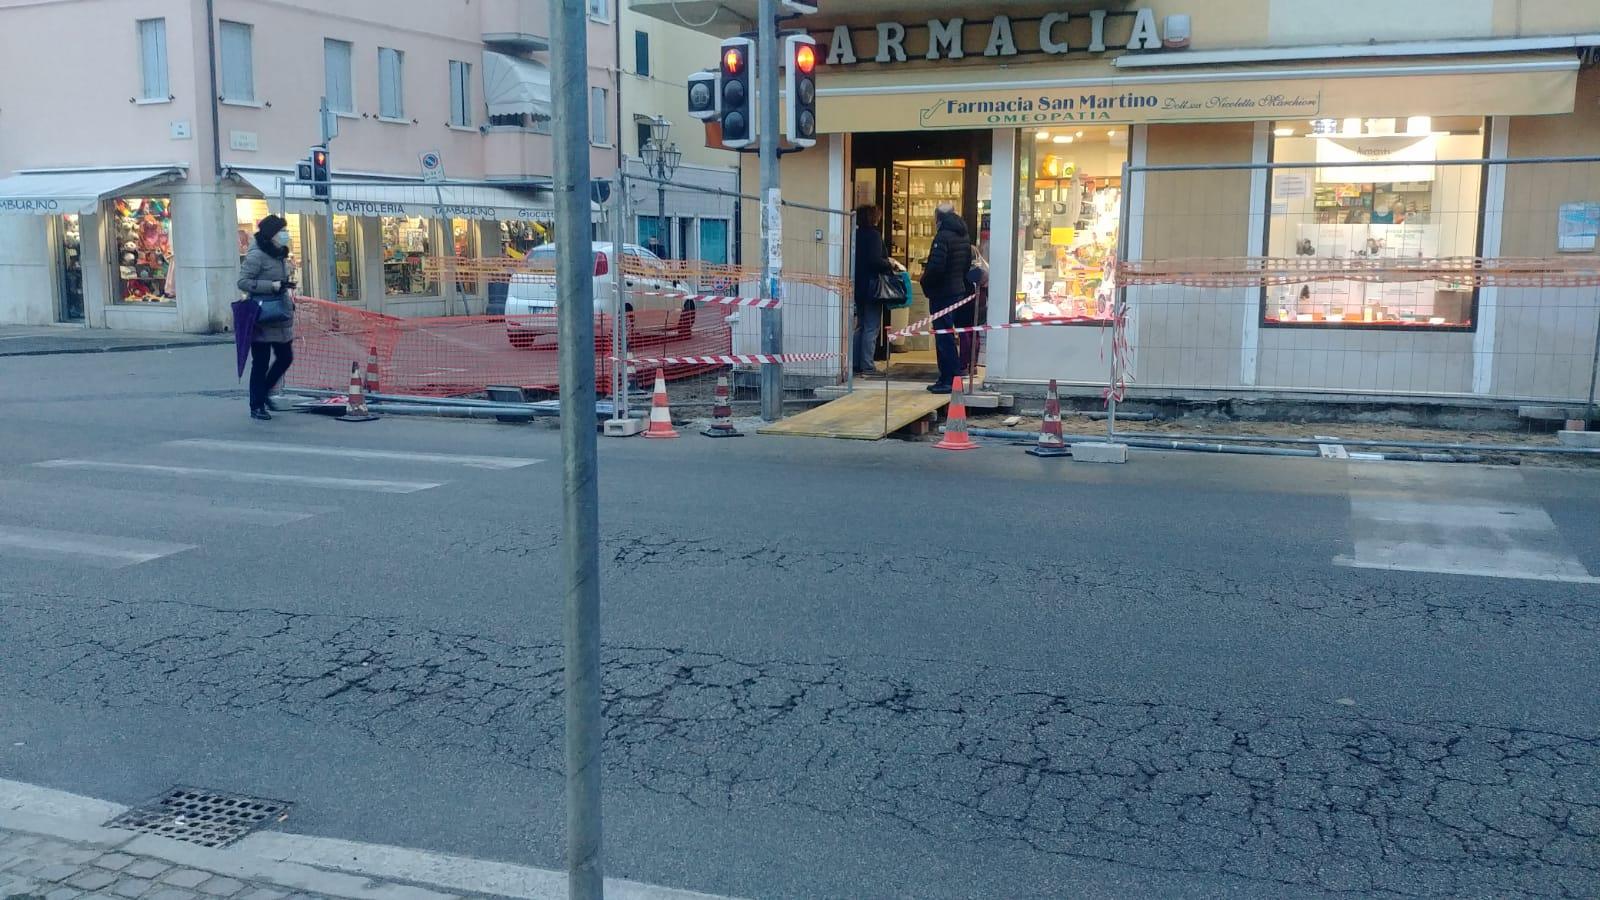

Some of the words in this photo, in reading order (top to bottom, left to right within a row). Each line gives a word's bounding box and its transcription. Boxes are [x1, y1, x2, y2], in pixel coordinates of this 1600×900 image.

[781, 8, 1163, 65] ARMACIA
[946, 97, 1034, 114] Farmacia
[1038, 96, 1074, 111] San
[1079, 93, 1158, 110] Martino
[1205, 96, 1256, 109] Nicoletta
[986, 111, 1111, 124] OMEOPATIA
[336, 201, 405, 214] CARTOLERIA
[432, 206, 496, 217] TAMBURINO
[518, 208, 554, 218] Giocatt
